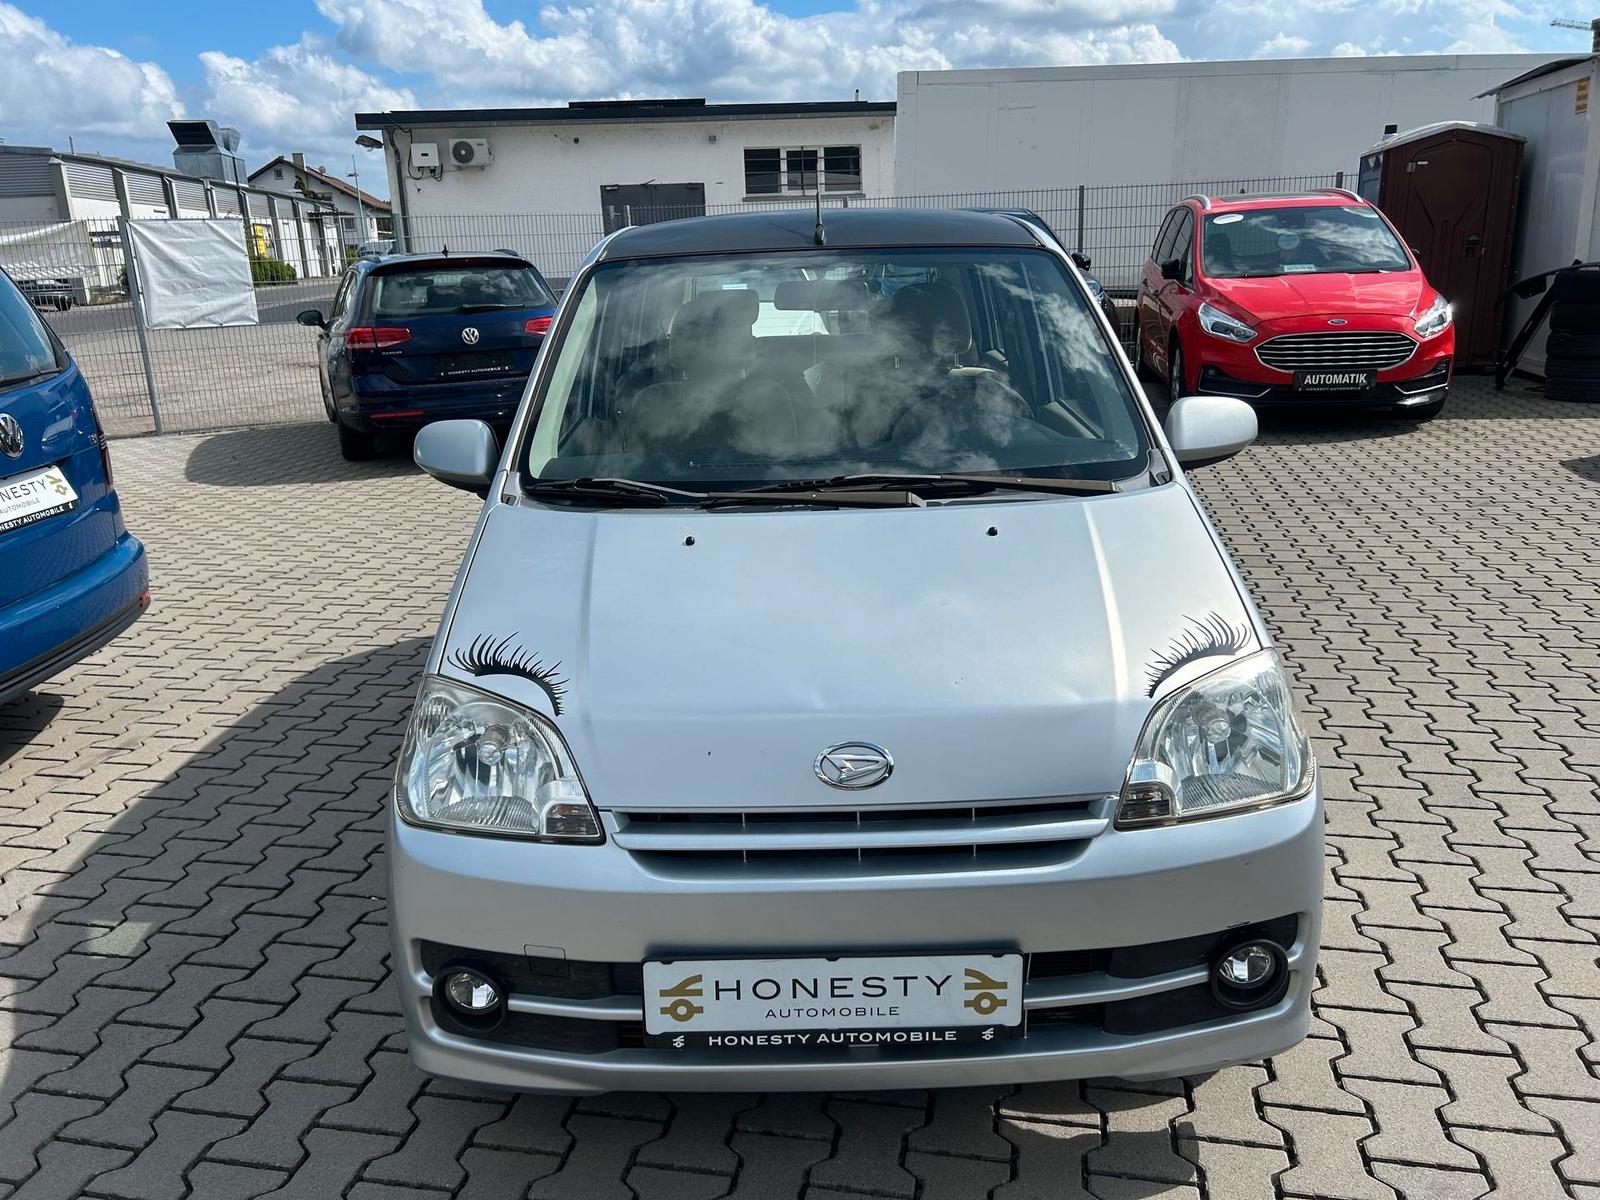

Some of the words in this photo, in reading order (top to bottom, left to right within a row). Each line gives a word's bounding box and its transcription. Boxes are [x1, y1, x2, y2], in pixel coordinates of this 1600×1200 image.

[1304, 373, 1367, 385] AUTOMATIK
[23, 505, 64, 523] AUTOMOBILE
[714, 974, 952, 1001] HONESTY
[765, 1006, 899, 1019] AUTOMOBILE
[708, 1033, 811, 1046] HONESTY
[816, 1031, 957, 1044] AUTOMOBILE
